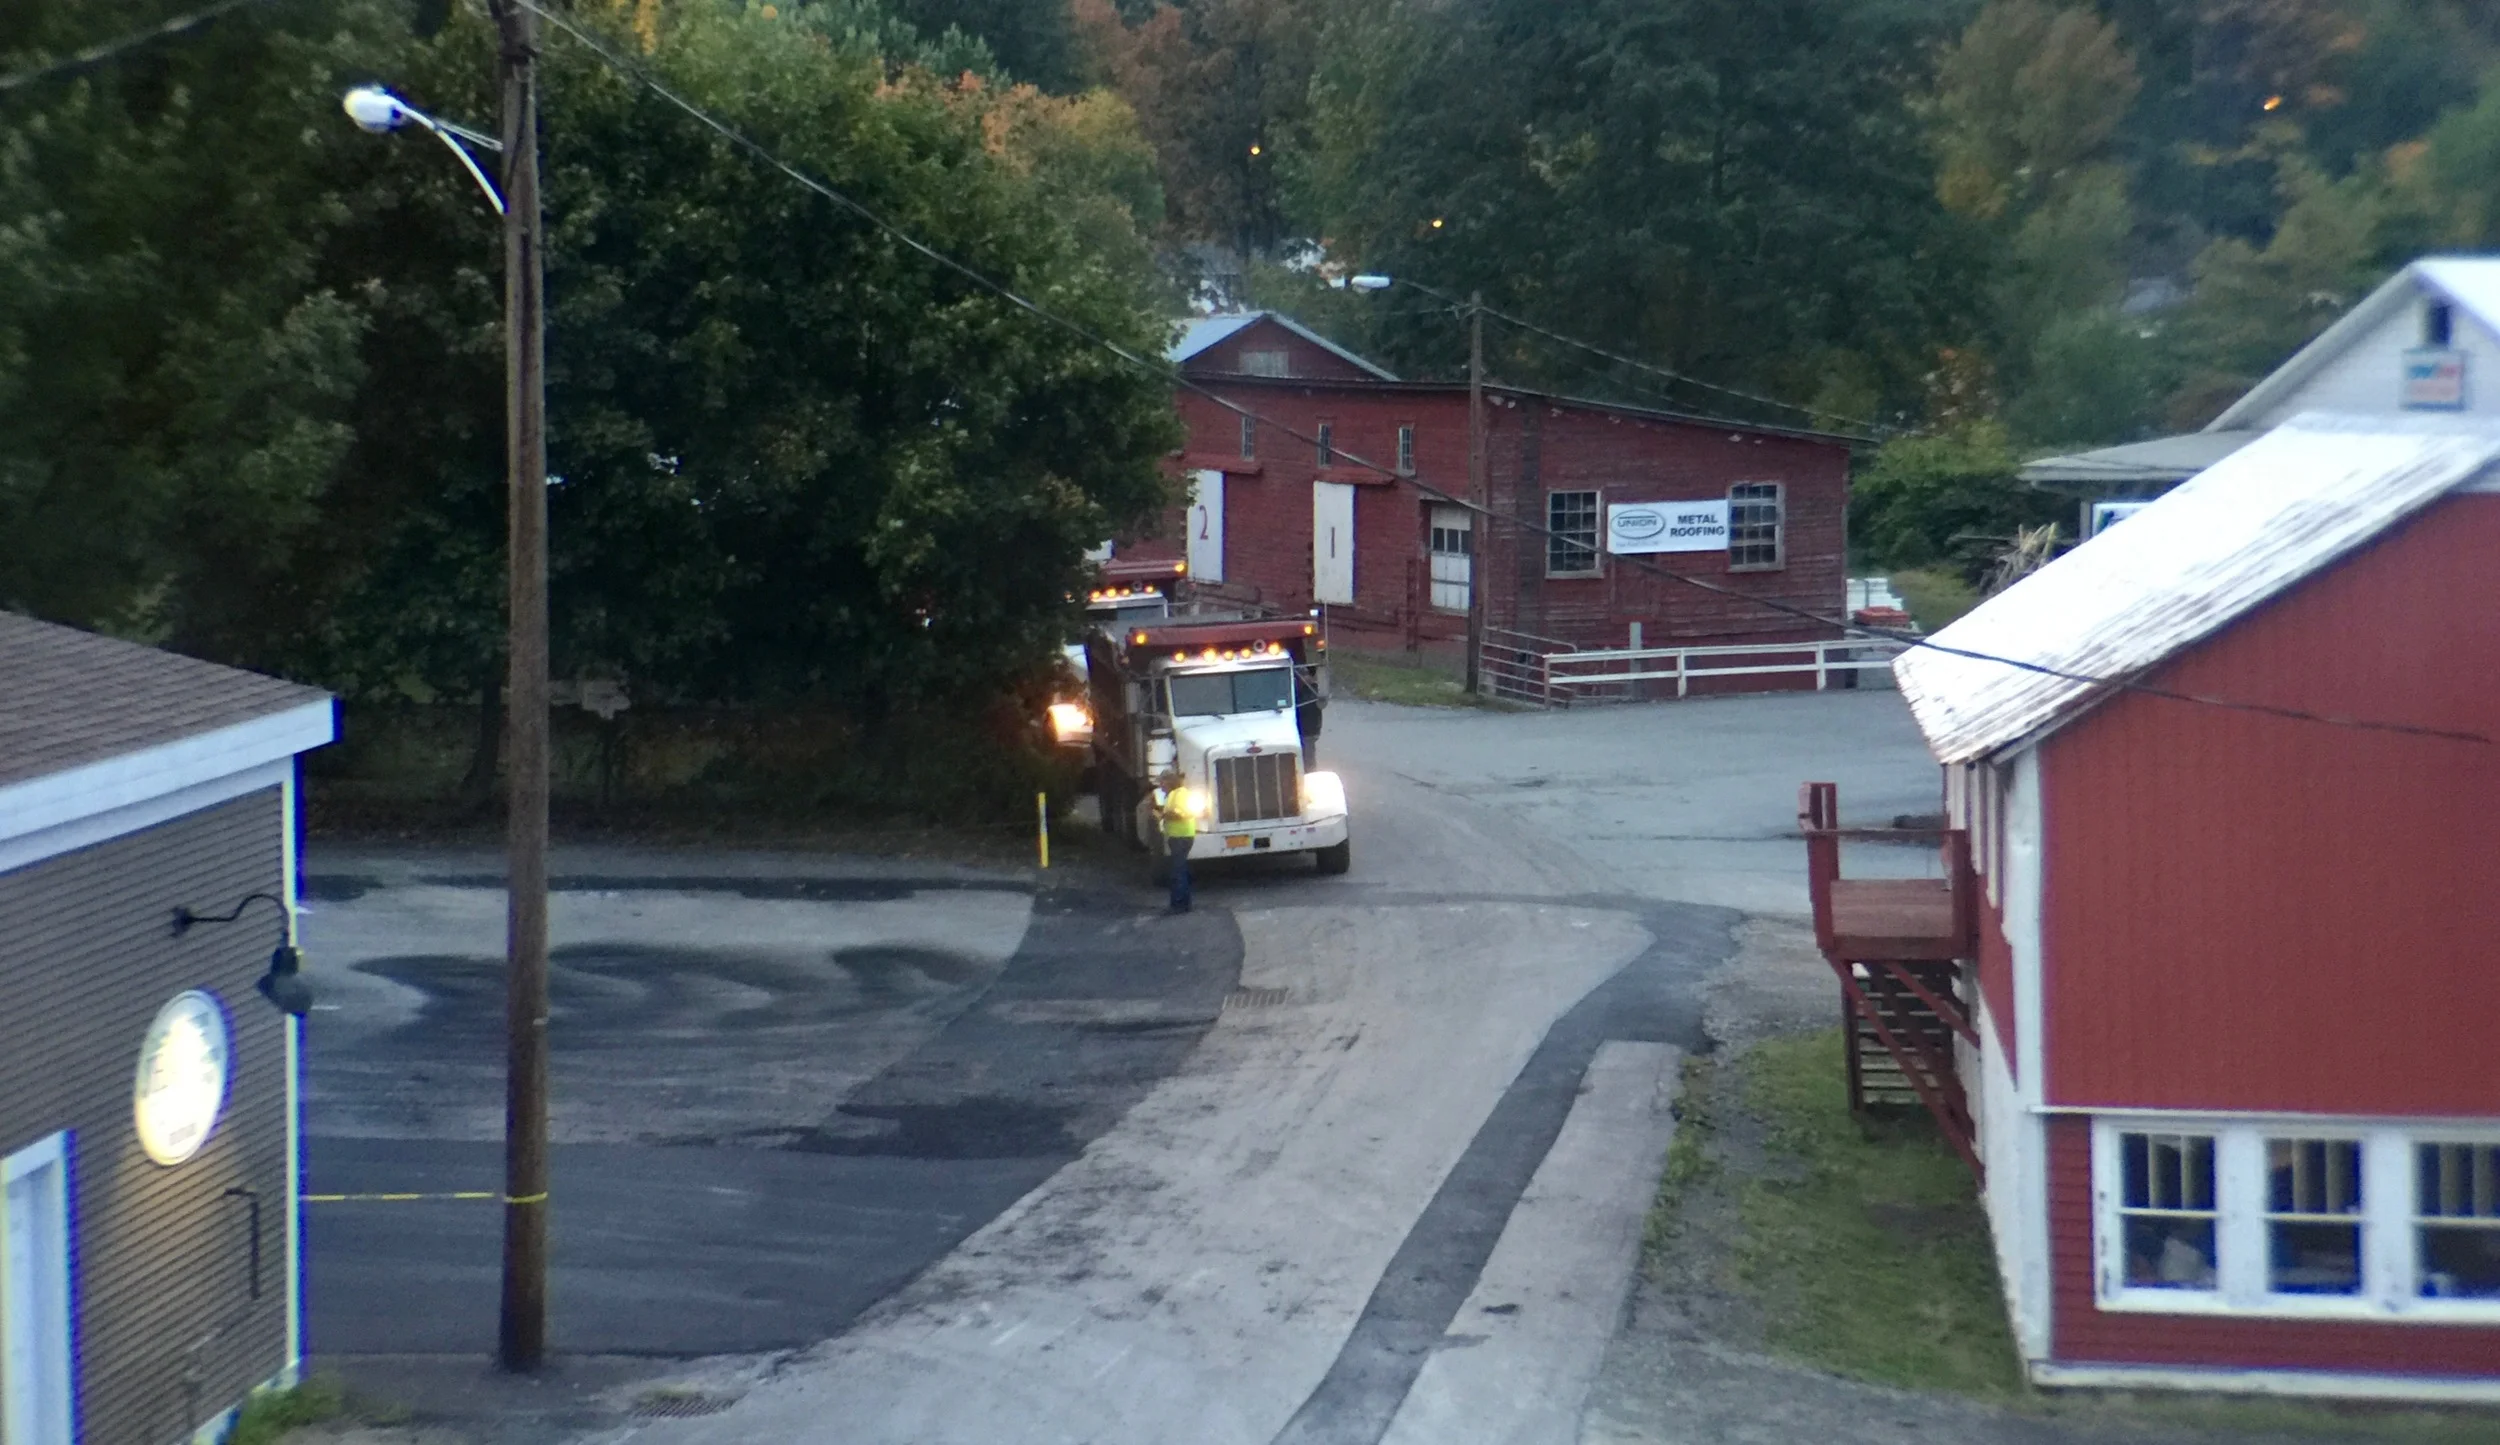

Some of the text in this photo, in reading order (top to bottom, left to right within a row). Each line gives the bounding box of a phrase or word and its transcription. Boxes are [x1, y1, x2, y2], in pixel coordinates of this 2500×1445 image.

[1199, 505, 1209, 541] 2
[1617, 519, 1657, 528] UNION
[1677, 514, 1718, 525] METAL
[1670, 526, 1725, 537] ROOFING
